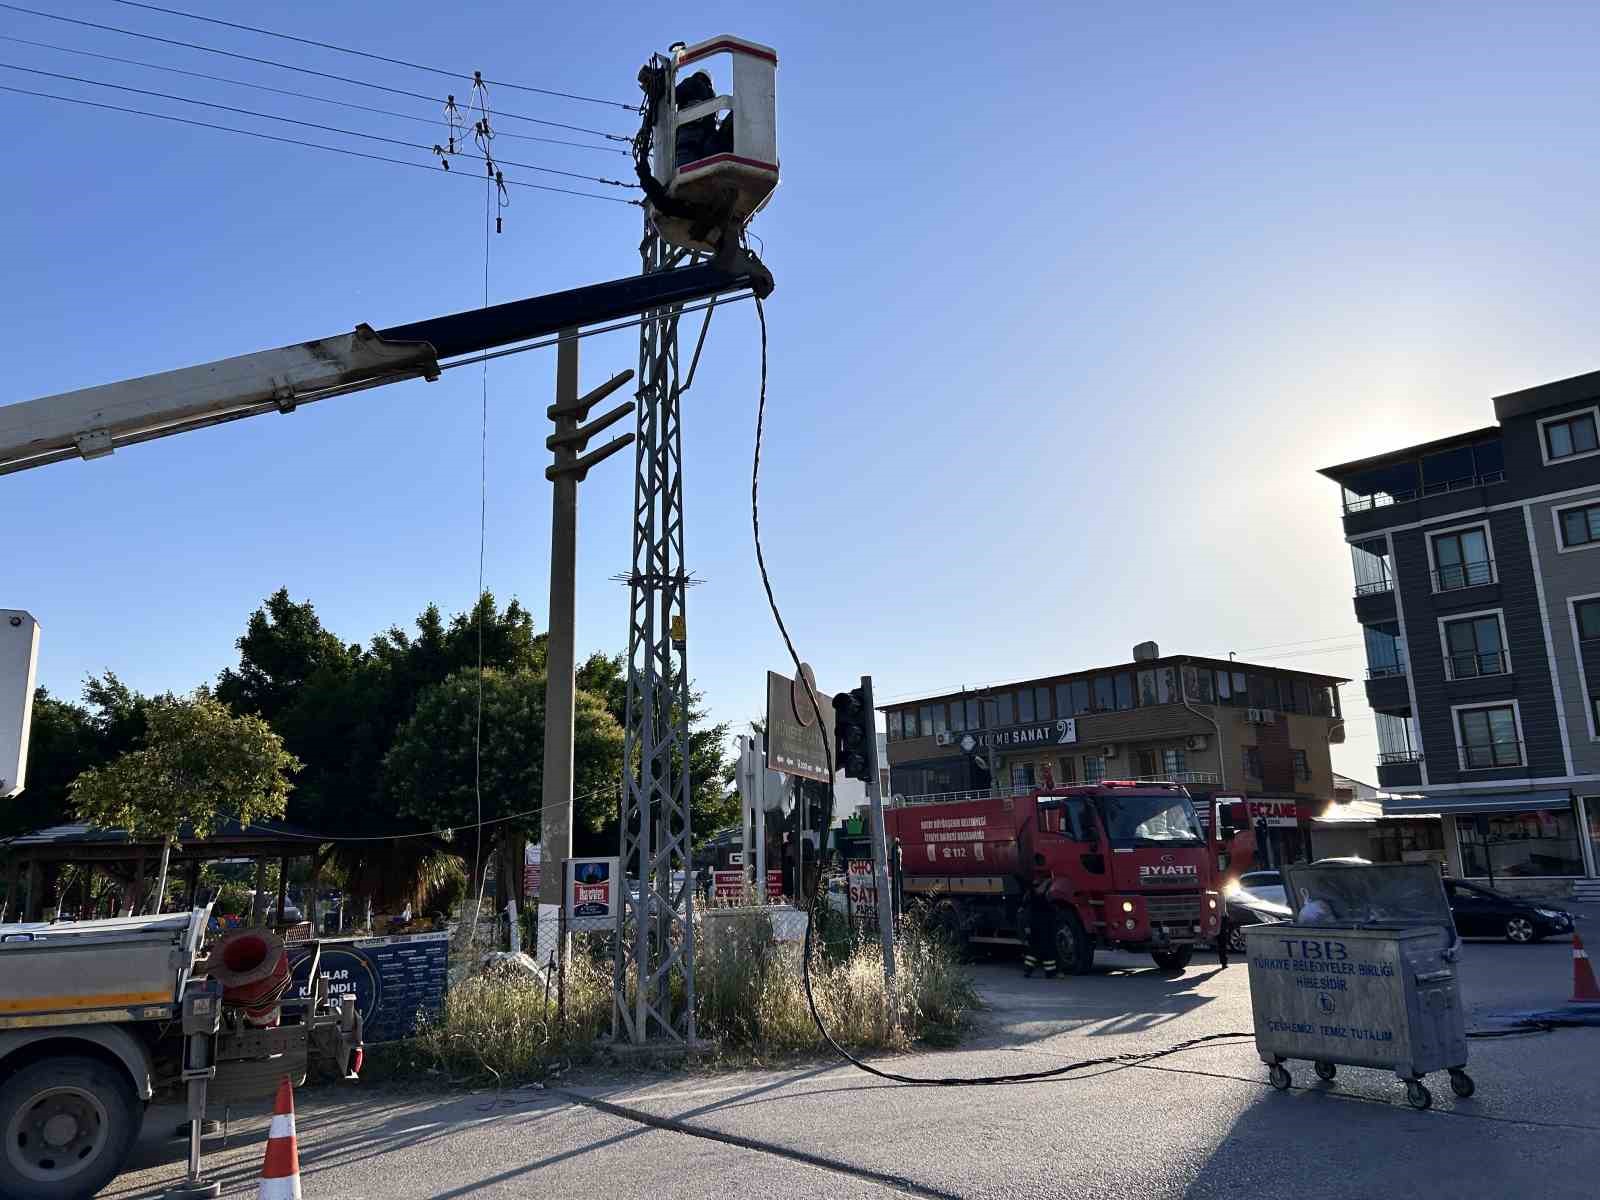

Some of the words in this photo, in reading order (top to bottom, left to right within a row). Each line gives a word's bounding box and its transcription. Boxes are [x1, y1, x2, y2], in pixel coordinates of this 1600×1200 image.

[1013, 727, 1050, 743] SANAT
[1249, 802, 1297, 816] ECZANE
[952, 847, 967, 857] 112
[1279, 939, 1348, 960] TBB
[1254, 957, 1290, 971] TÜRKİYE
[1292, 959, 1357, 976] BELEDİYELER
[1358, 959, 1394, 977] BİRLİĞİ
[1296, 975, 1348, 992] HİBESİDİR
[1319, 1023, 1349, 1038] TEMİZ
[1350, 1027, 1393, 1042] TUTALIM
